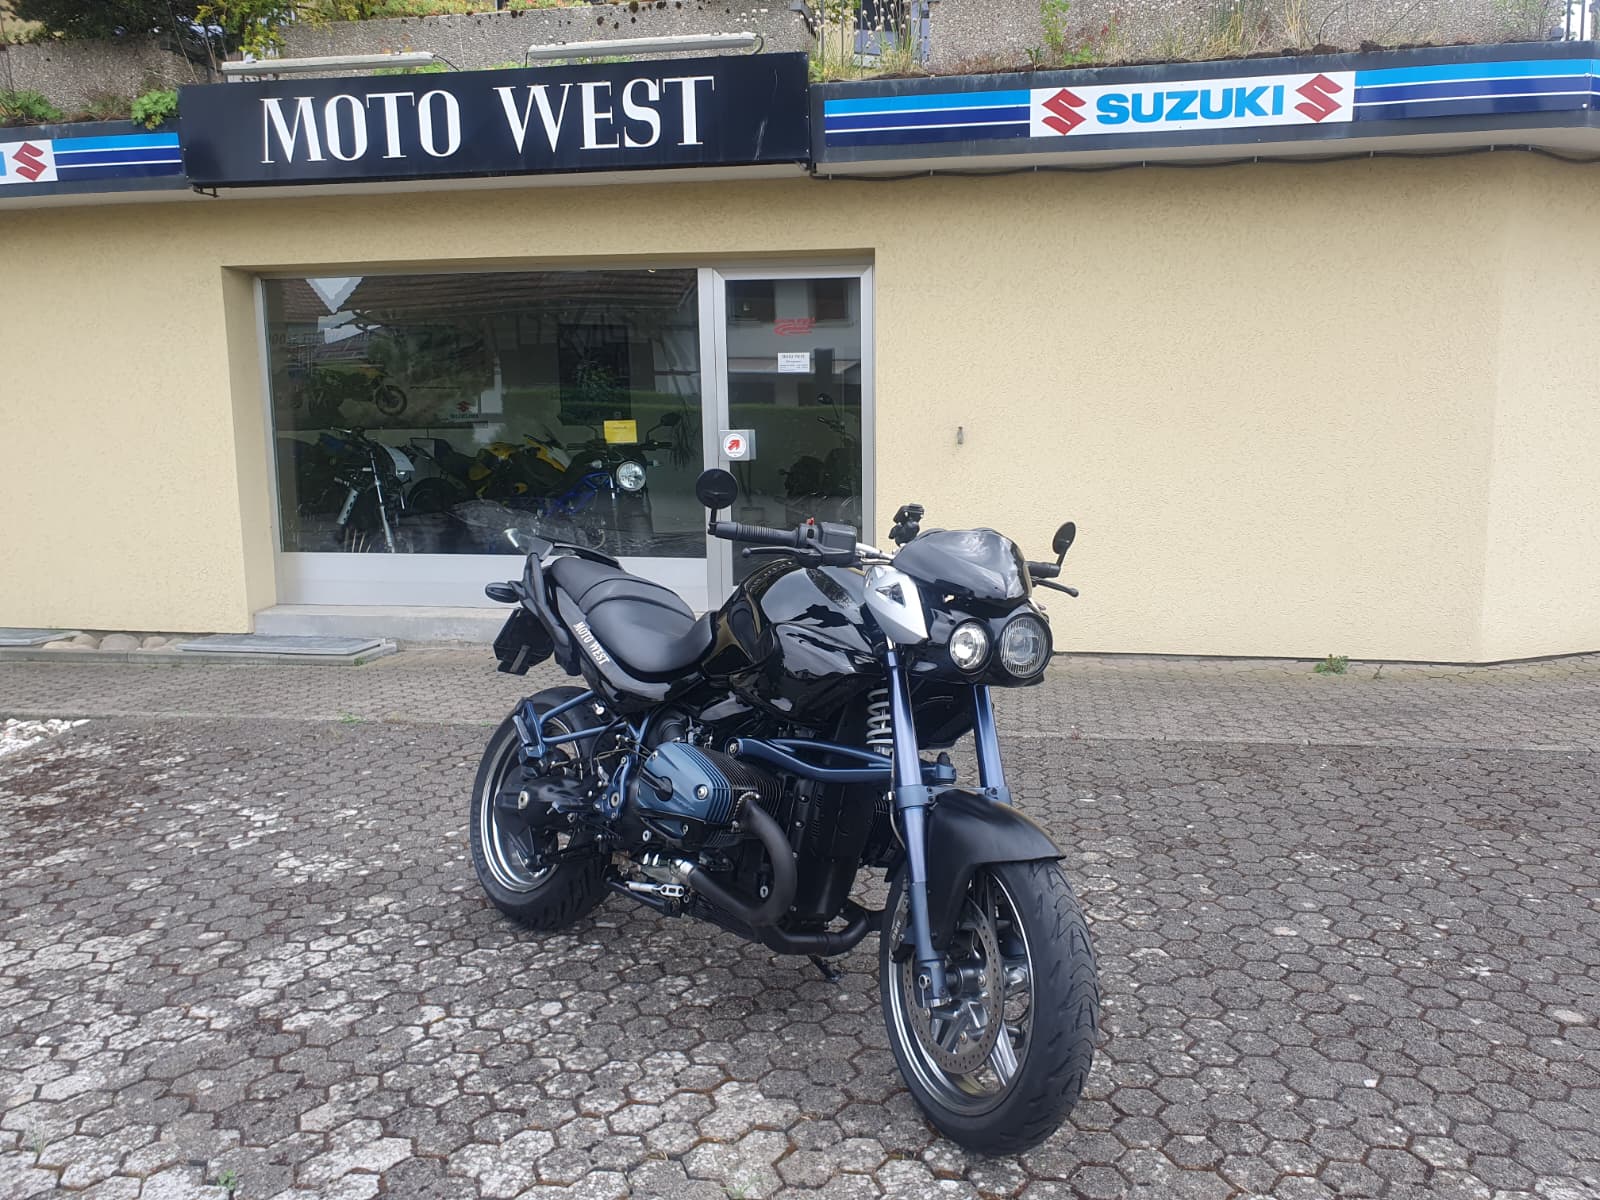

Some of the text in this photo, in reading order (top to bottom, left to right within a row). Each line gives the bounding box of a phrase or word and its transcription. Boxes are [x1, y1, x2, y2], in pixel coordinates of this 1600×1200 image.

[260, 76, 715, 164] MOTO WEST
[1096, 84, 1285, 125] SUZUKI
[573, 621, 610, 665] MOTO WEST
